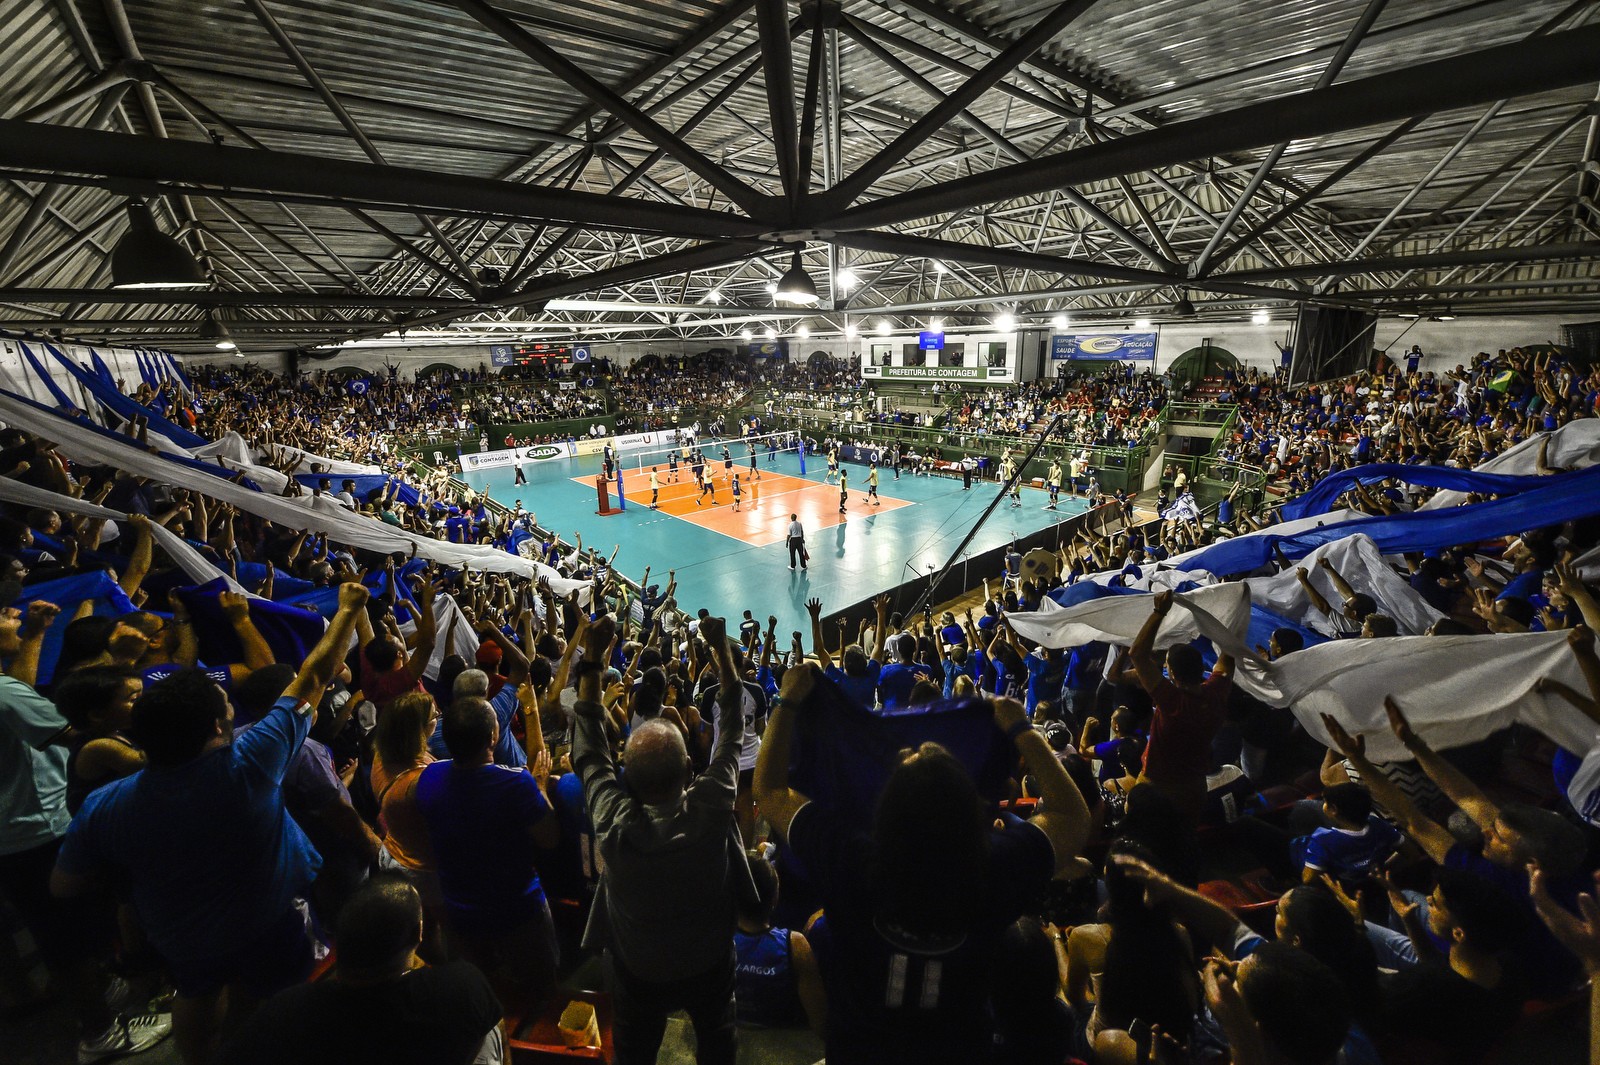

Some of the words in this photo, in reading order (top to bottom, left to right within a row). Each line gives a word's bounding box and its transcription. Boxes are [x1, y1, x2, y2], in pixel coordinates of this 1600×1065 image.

[888, 368, 927, 376] PREFEITURA
[938, 369, 978, 377] CONTAGEM
[528, 448, 558, 457] SADA
